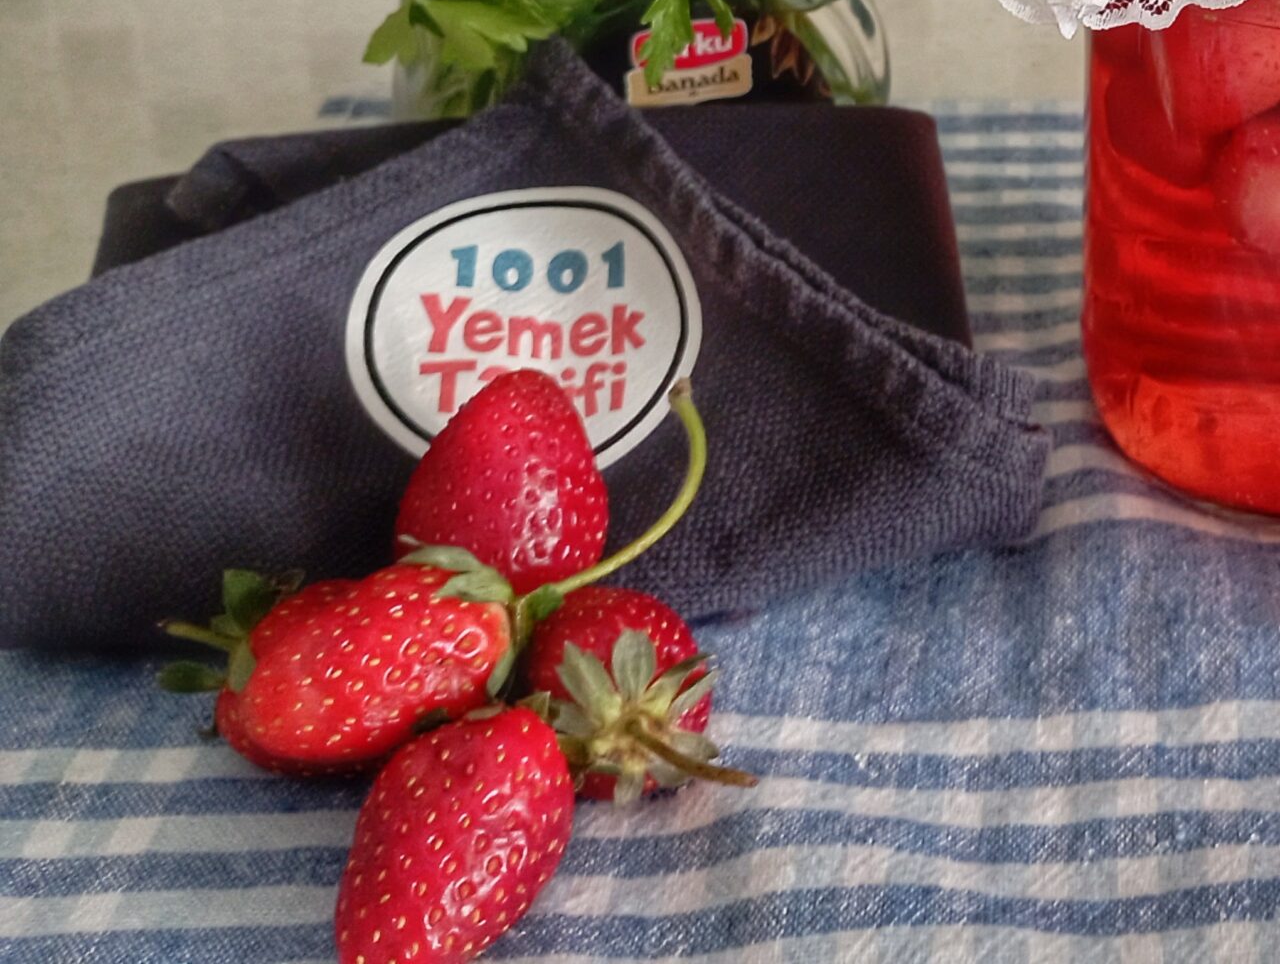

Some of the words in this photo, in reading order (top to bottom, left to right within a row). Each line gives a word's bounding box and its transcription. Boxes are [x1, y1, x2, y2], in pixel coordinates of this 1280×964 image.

[450, 240, 626, 294] 1001
[419, 293, 646, 360] Yemek
[419, 360, 628, 417] Tifi
